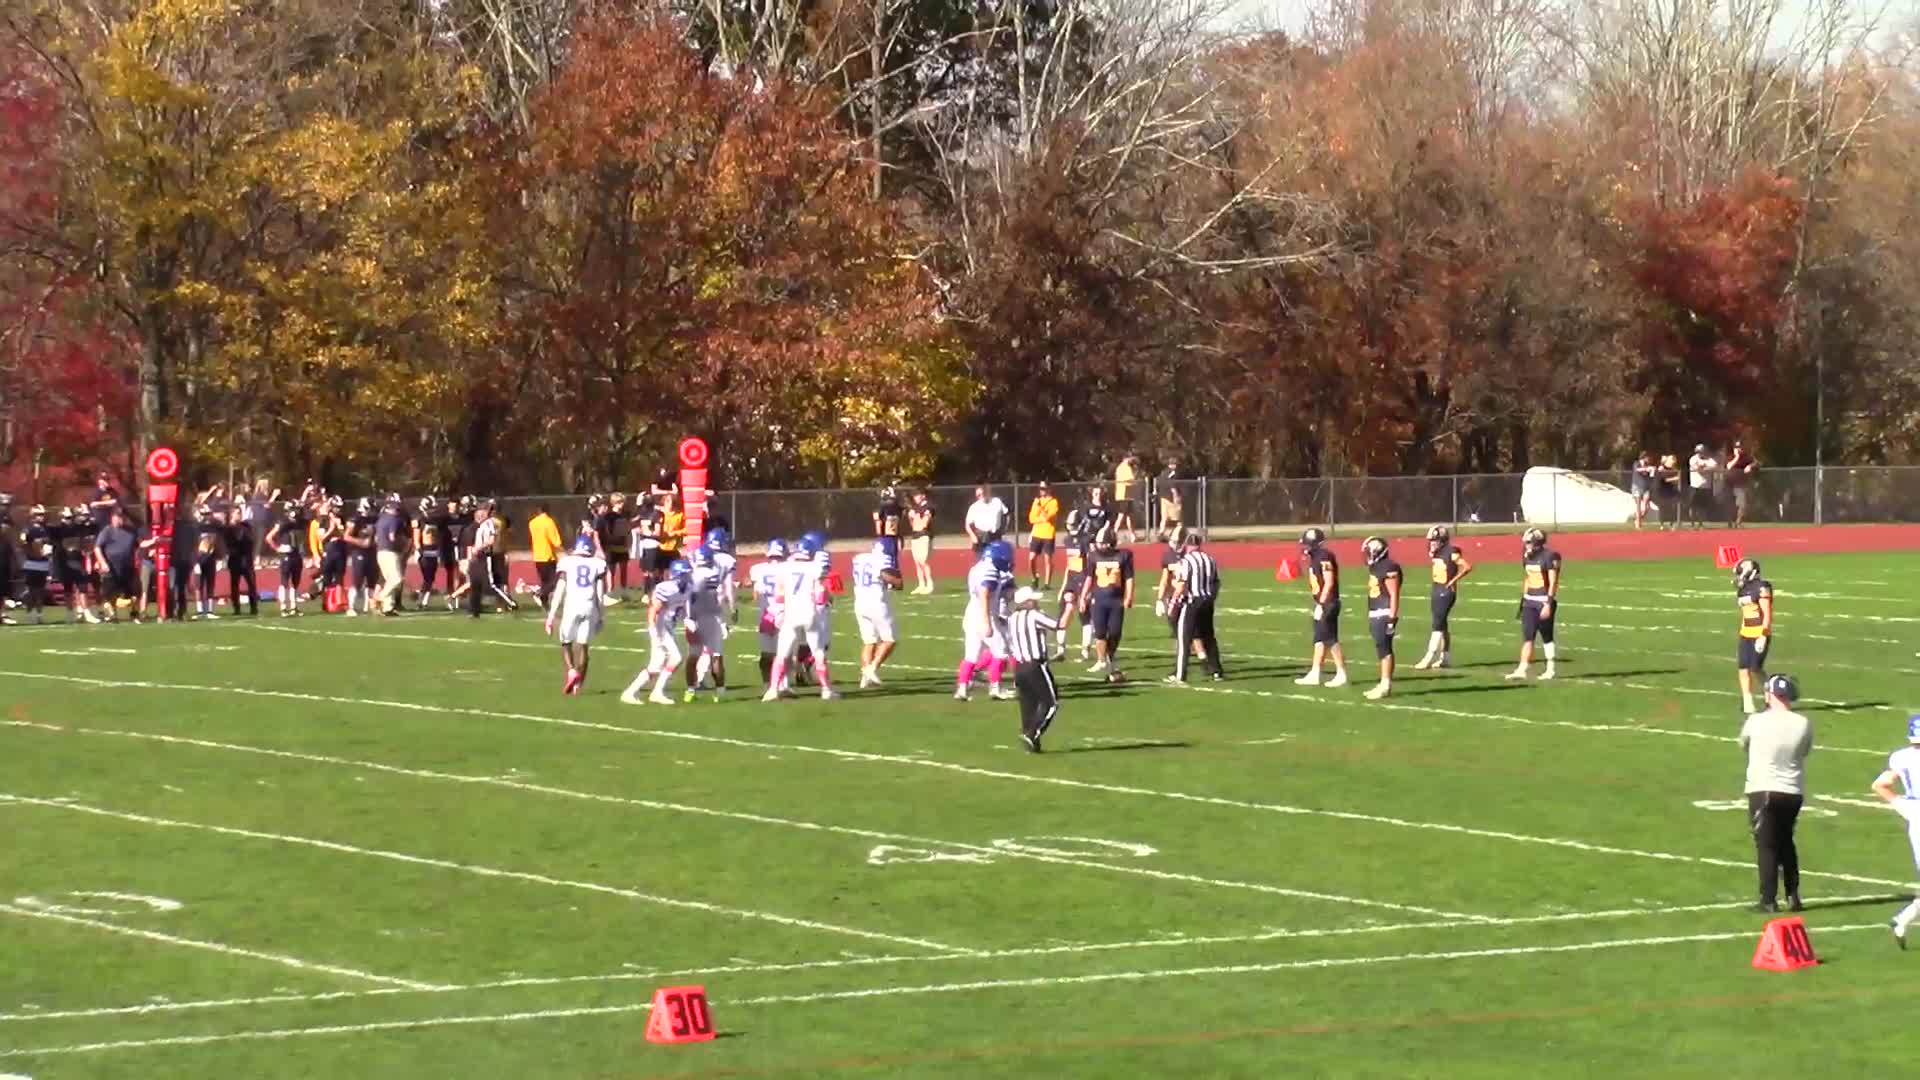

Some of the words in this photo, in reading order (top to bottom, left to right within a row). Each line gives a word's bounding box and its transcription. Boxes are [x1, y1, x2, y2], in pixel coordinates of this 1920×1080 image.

[576, 564, 592, 588] 8
[791, 572, 805, 596] 7
[1782, 924, 1815, 962] 40
[666, 994, 710, 1035] 30
